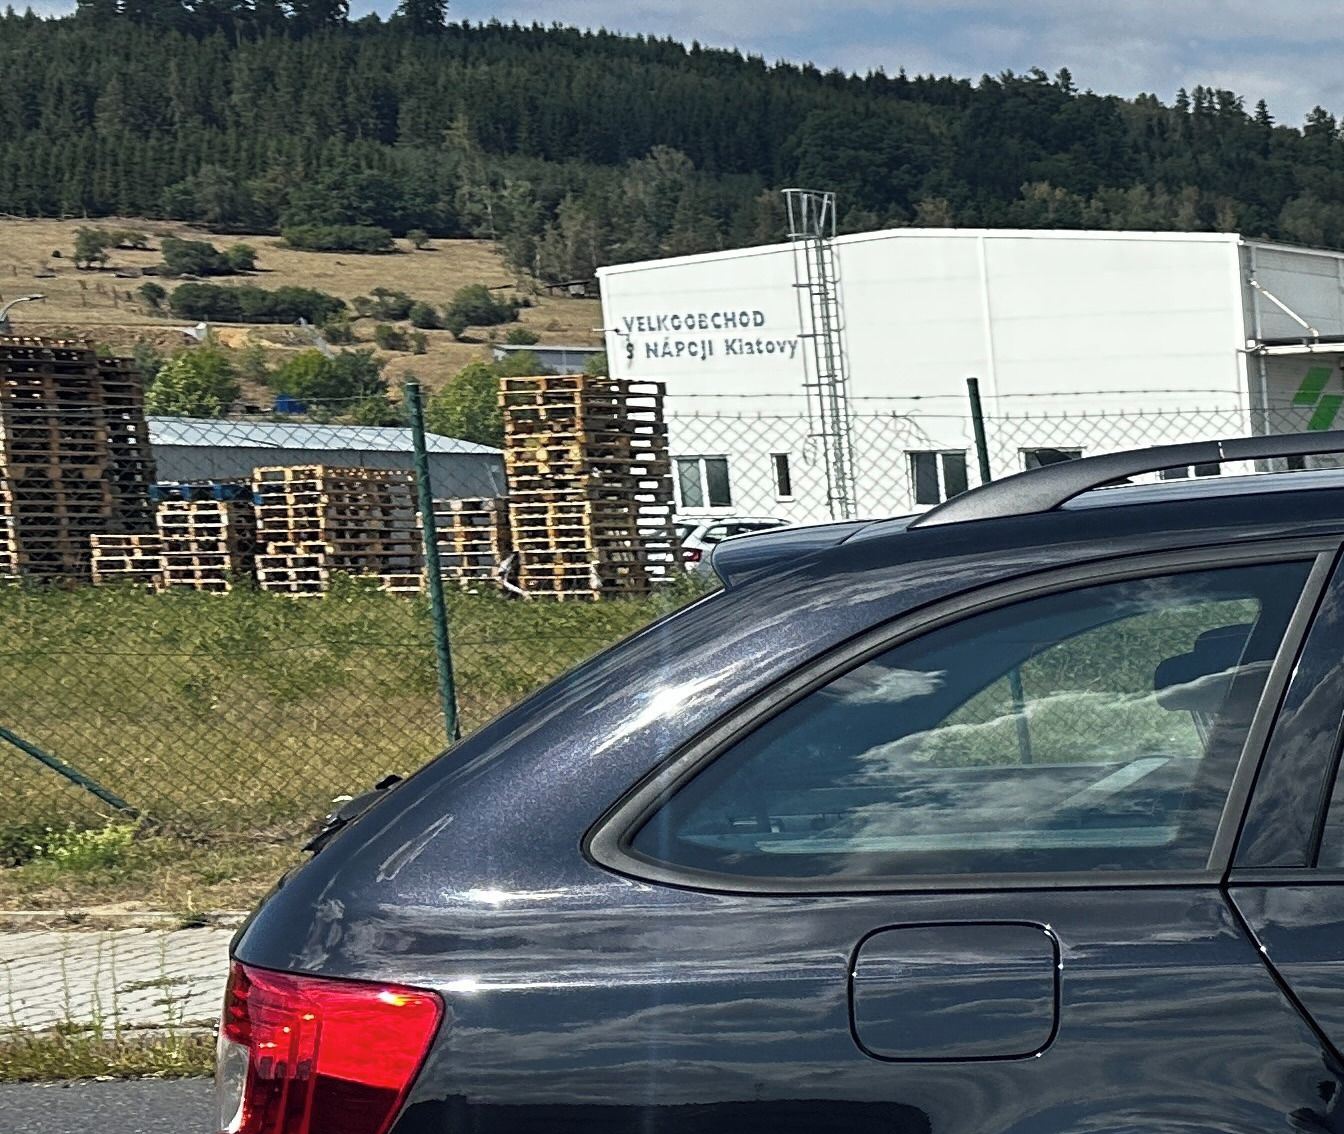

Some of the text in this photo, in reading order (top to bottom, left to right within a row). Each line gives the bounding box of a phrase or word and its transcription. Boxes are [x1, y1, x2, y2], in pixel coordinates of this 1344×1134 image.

[622, 311, 765, 332] VELKOOBCHOD
[645, 336, 714, 360] NÁPOJI
[724, 338, 798, 359] Klatovy
